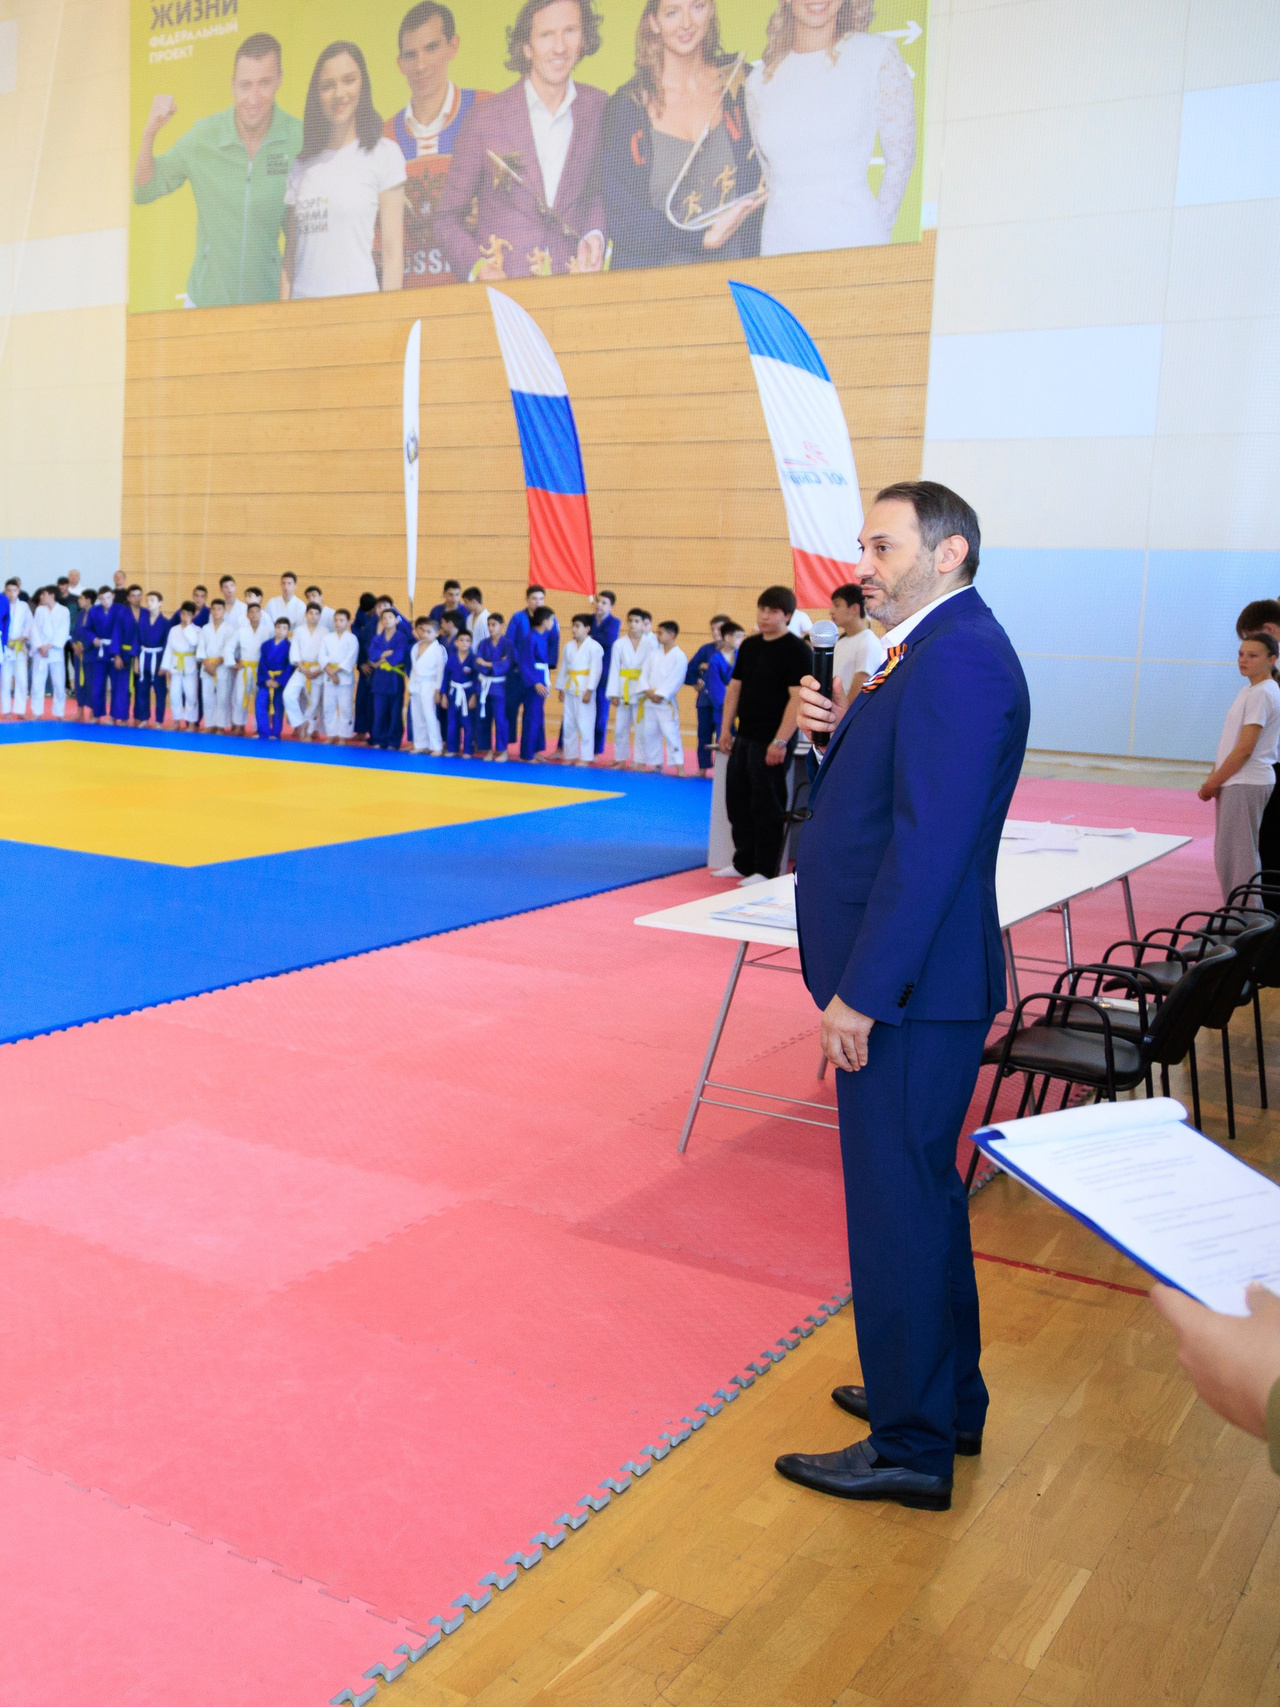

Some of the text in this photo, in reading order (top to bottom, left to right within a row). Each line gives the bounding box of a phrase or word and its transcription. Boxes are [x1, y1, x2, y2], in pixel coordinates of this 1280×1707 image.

[150, 0, 238, 30] ЖИЗНИ
[148, 17, 238, 48] ФЕДЕРАЛЬНЫЙ
[148, 44, 194, 64] ПРОЕКТ
